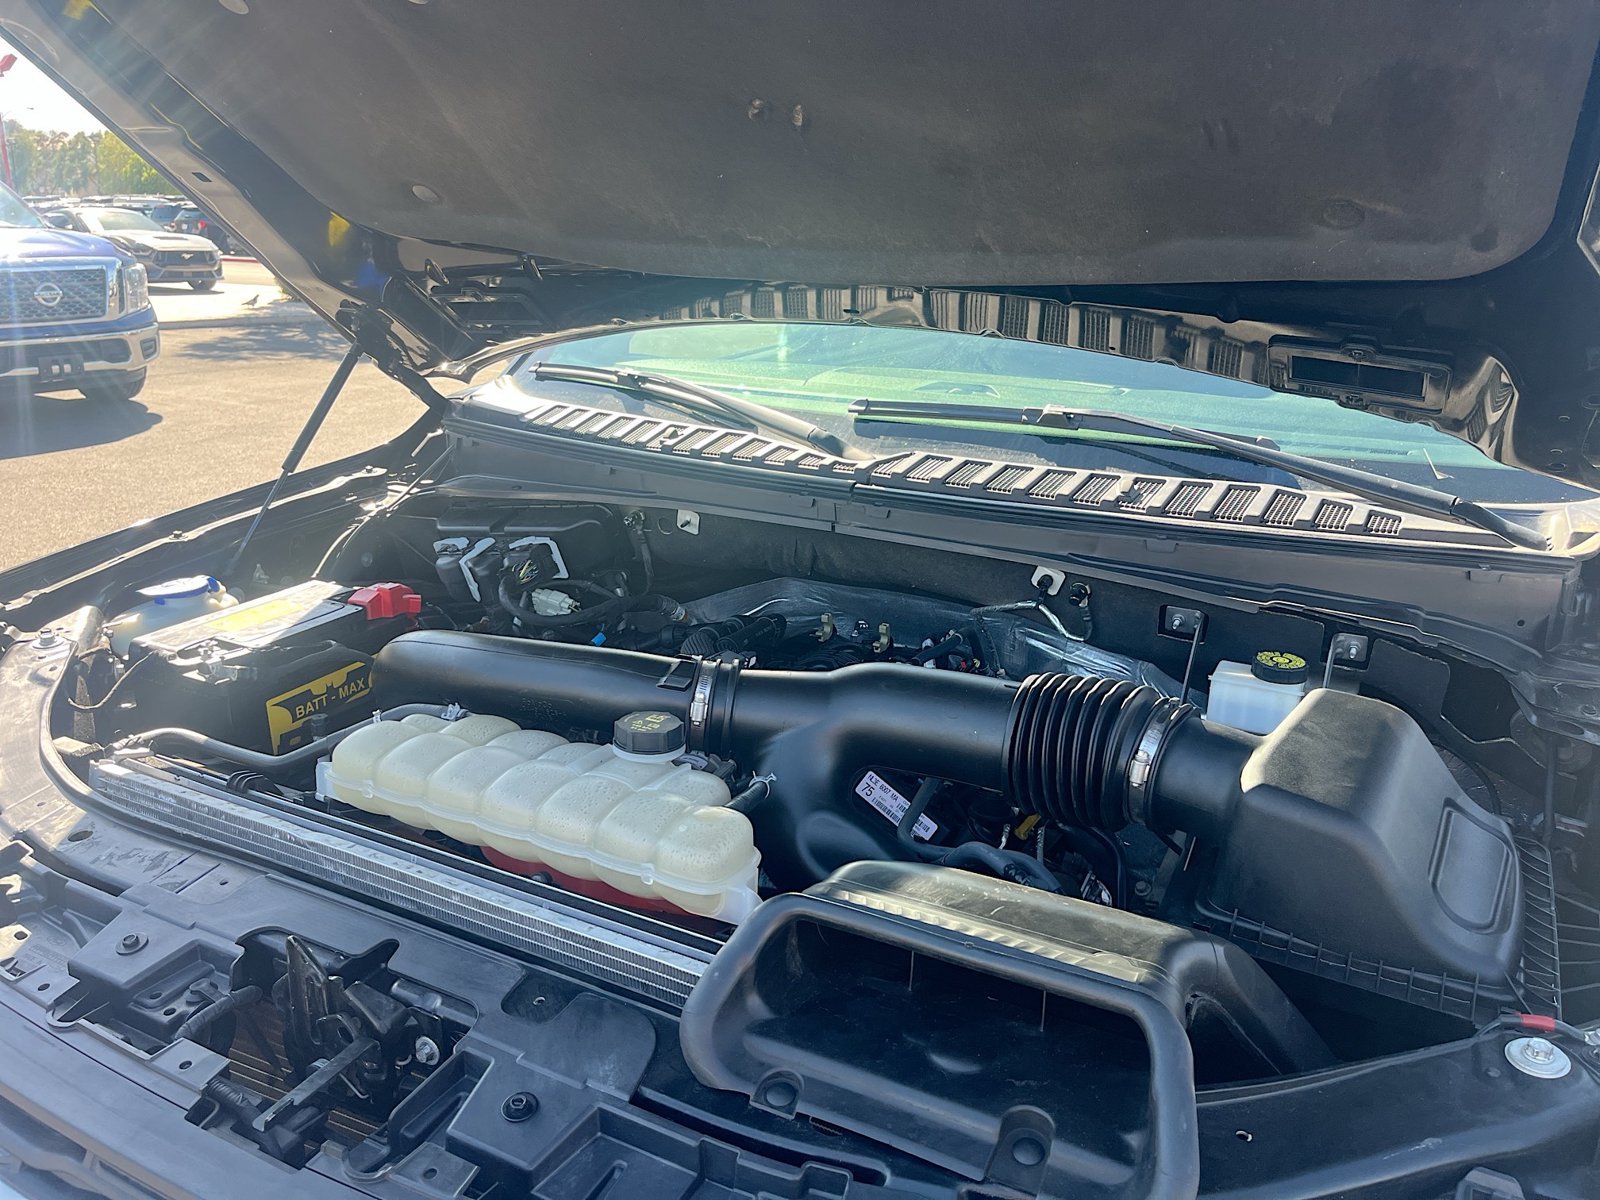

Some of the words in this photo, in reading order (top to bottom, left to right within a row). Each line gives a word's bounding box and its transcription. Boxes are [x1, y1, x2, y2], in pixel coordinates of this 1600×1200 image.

[296, 694, 328, 719] BATT
[338, 678, 365, 699] MAX
[861, 782, 875, 797] 75
